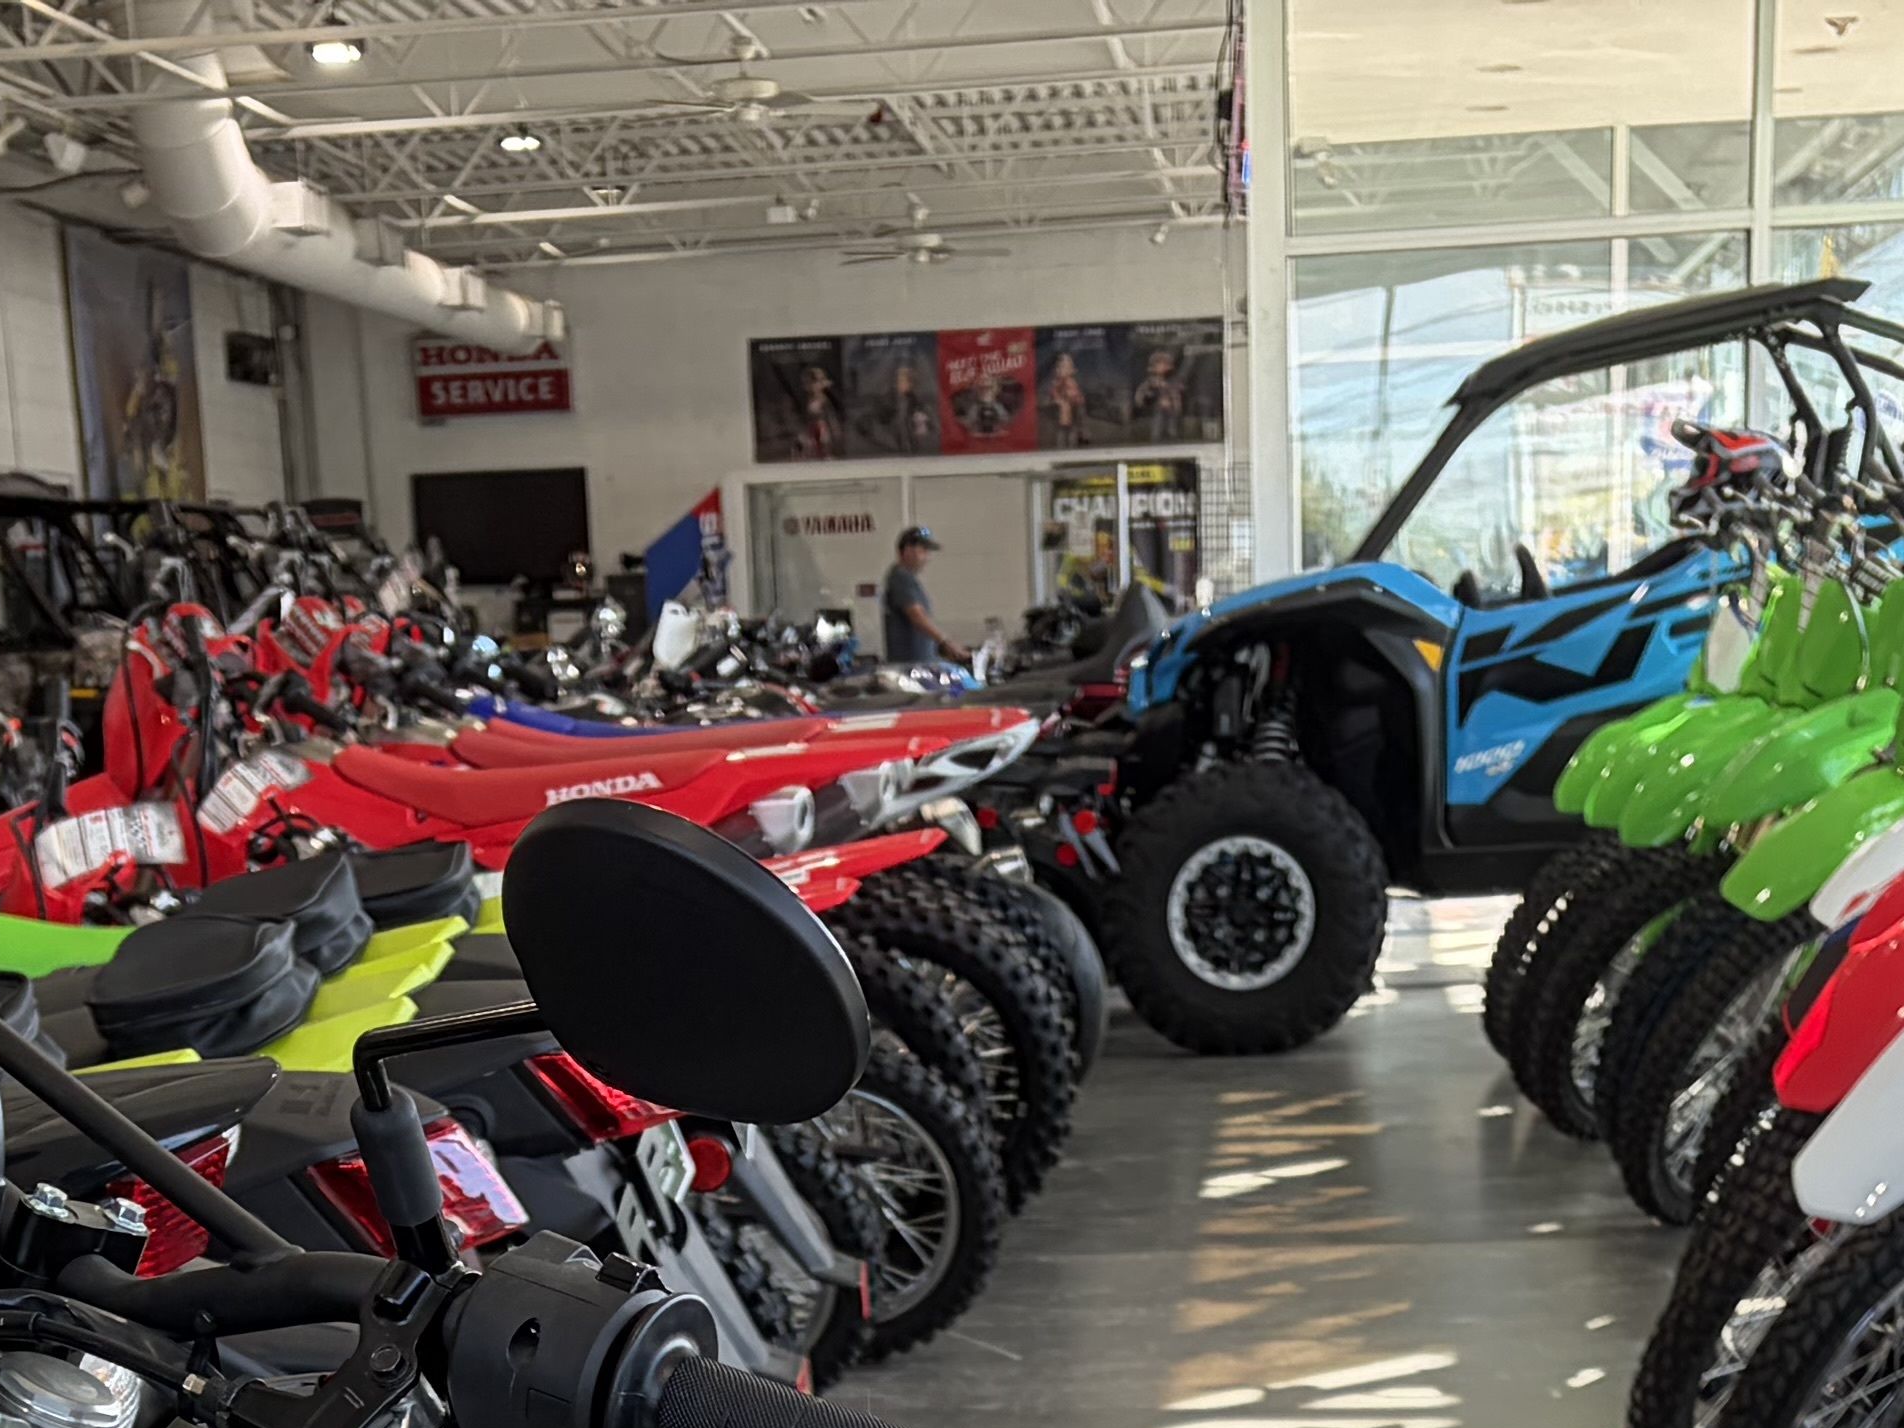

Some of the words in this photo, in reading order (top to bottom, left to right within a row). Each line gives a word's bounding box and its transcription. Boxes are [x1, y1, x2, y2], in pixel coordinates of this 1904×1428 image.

[420, 340, 560, 367] HONA
[431, 374, 555, 406] SERVICE
[1053, 490, 1195, 523] CHAPION
[545, 771, 664, 808] HONDA
